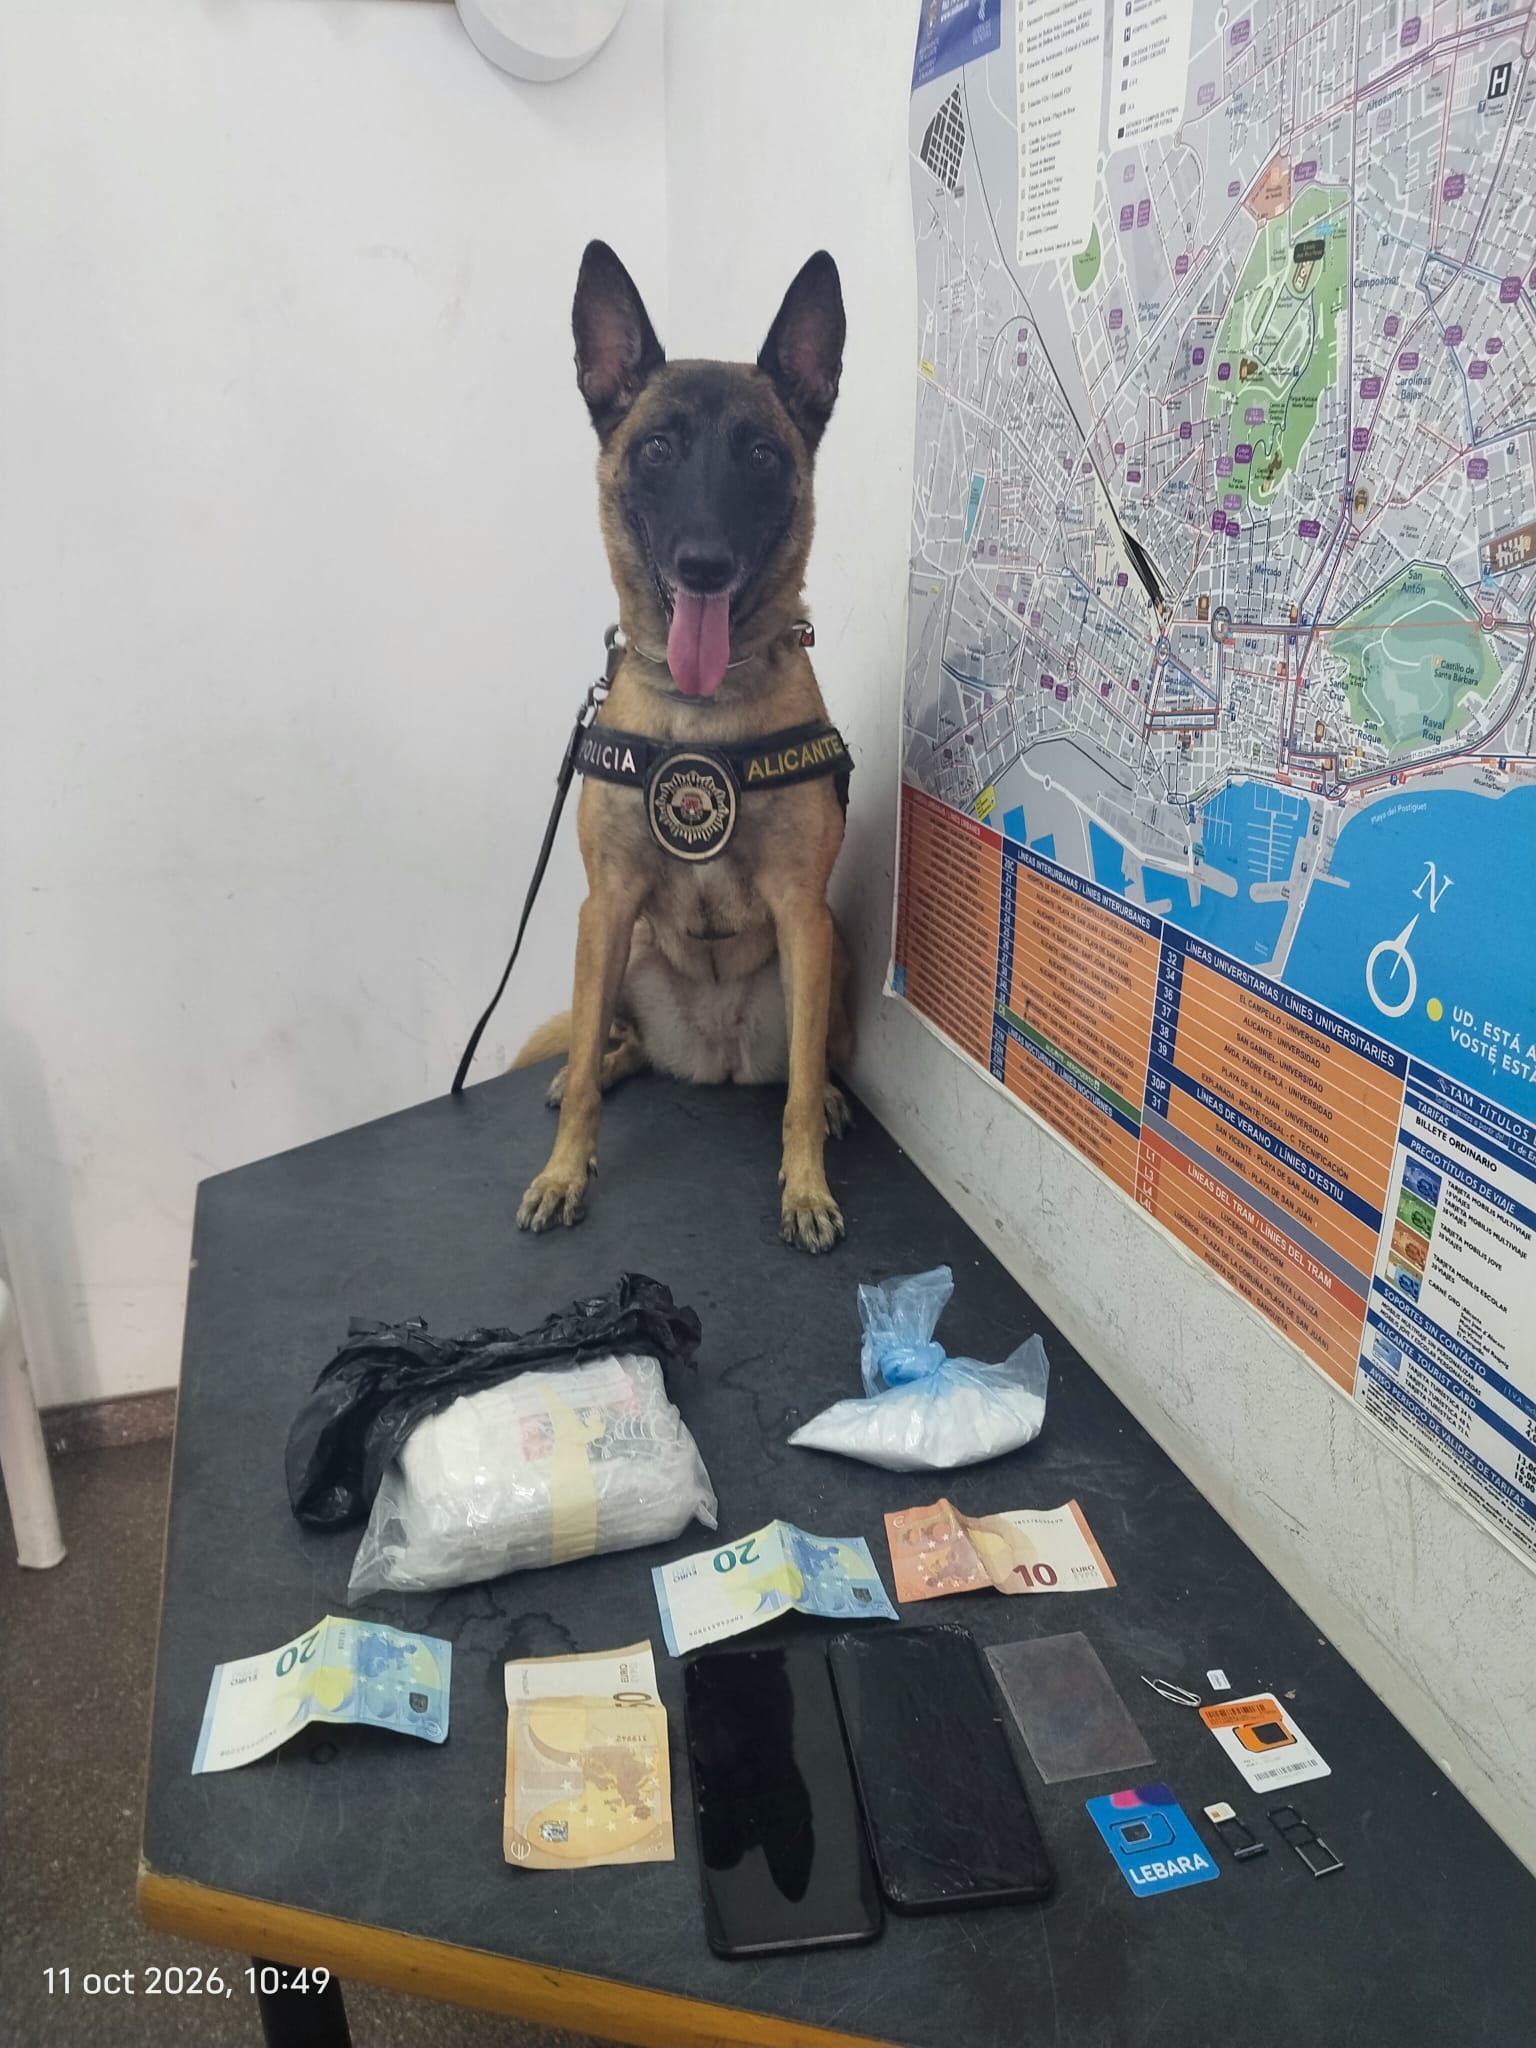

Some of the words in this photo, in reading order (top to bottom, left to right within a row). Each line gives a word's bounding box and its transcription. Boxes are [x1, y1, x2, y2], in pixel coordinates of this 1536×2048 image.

[1366, 87, 1402, 113] Altozano
[1395, 376, 1432, 386] Carolinas
[1401, 390, 1423, 401] Bajas
[1254, 564, 1282, 577] Mercado
[1408, 571, 1422, 581] San
[1401, 583, 1425, 595] Antón
[1434, 669, 1452, 680] Santa
[1453, 672, 1479, 686] Bárbara
[1440, 660, 1463, 674] Castillo
[1465, 664, 1475, 674] de
[1329, 677, 1349, 691] Santa
[1329, 690, 1345, 702] Cruz
[1357, 730, 1381, 745] Roque
[1364, 718, 1378, 730] San
[1422, 715, 1446, 730] Raval
[1422, 729, 1442, 745] Roig
[747, 734, 843, 782] ALICANTE
[1036, 860, 1078, 891] INTERURBANAS
[1082, 884, 1101, 902] LÍNIES
[1102, 894, 1151, 929] INTERURBANES
[1412, 861, 1455, 913] N
[1165, 967, 1176, 982] 34
[1167, 951, 1177, 966] 32
[1163, 986, 1174, 1001] 36
[1185, 939, 1213, 964] LÍNEAS
[1213, 955, 1279, 1001] UNIVERSITARIAS
[1284, 994, 1314, 1021] LÍNIES
[1314, 1014, 1395, 1068] UNIVERSITARIES
[1161, 1006, 1172, 1020] 37
[1248, 999, 1282, 1026] CAMPELLO
[1285, 1021, 1331, 1054] UNIVERSIDAD
[1453, 1006, 1477, 1031] UD.
[1483, 1022, 1520, 1053] ESTÁ
[1159, 1023, 1170, 1039] 38
[1243, 1016, 1273, 1040] ALICANTE
[1277, 1036, 1321, 1069] UNIVERSIDAD
[1450, 1026, 1498, 1062] VOSTÉ
[1157, 1041, 1168, 1057] 39
[1236, 1032, 1249, 1045] SAN
[1279, 1059, 1324, 1093] UNIVERSIDAD
[1151, 1075, 1166, 1092] 30P
[1242, 1055, 1262, 1074] PADRE
[1288, 1085, 1333, 1121] UNIVERSIDAD
[1151, 1094, 1162, 1110] 31
[1221, 1065, 1240, 1083] PLAYA
[1249, 1084, 1263, 1098] SAN
[1263, 1092, 1281, 1111] JUAN
[1284, 1106, 1329, 1144] UNIVERSIDAD
[1418, 1101, 1449, 1127] TARIFAS
[1449, 1085, 1474, 1107] TAM
[1479, 1103, 1529, 1140] TÍTULOS
[1201, 1072, 1235, 1102] EXPLANADA
[1238, 1098, 1259, 1117] MONTE
[1261, 1113, 1284, 1136] TOSSAL
[1298, 1140, 1349, 1181] TECNIFICACIÓN
[1145, 1148, 1156, 1163] L1
[1196, 1087, 1224, 1114] LÍNEAS
[1224, 1106, 1238, 1124] DE
[1237, 1115, 1271, 1149] VERANO
[1278, 1145, 1307, 1174] LÍNIES
[1307, 1165, 1345, 1202] D'ESTIU
[1415, 1116, 1447, 1142] BILLETE
[1449, 1137, 1497, 1173] ORDINARIO
[1144, 1166, 1154, 1181] L3
[1215, 1123, 1228, 1138] SAN
[1228, 1132, 1252, 1157] VICENTE
[1257, 1152, 1277, 1174] PLAYA
[1287, 1175, 1301, 1191] SAN
[1300, 1184, 1320, 1206] JUAN
[1410, 1140, 1441, 1165] PRECIO
[1442, 1158, 1478, 1190] TÍTULOS
[1479, 1185, 1492, 1199] DE
[1493, 1192, 1516, 1215] VIAJE
[1142, 1182, 1152, 1197] L4
[1215, 1145, 1247, 1175] MUTXAMEL
[1251, 1172, 1271, 1194] PLAYA
[1280, 1193, 1294, 1210] SAN
[1293, 1203, 1313, 1225] JUAN
[1173, 1210, 1200, 1236] LUCEROS
[1187, 1164, 1215, 1192] LÍNEAS
[1215, 1186, 1231, 1207] DEL
[1232, 1196, 1255, 1226] TRAM
[1260, 1220, 1287, 1251] LÍNIES
[1287, 1245, 1305, 1267] DEL
[1306, 1260, 1332, 1289] TRAM
[1448, 1180, 1471, 1200] TARJETA
[1472, 1197, 1496, 1217] MOBILIS
[1497, 1214, 1532, 1240] MULTIVIAJE
[1220, 1211, 1248, 1239] LUCEROS
[1251, 1237, 1284, 1269] BENIDORM
[1444, 1199, 1467, 1218] TARJETA
[1468, 1215, 1492, 1235] MOBILIS
[1493, 1232, 1527, 1259] MULTIVIAJE
[1197, 1210, 1224, 1238] LUCEROS
[1236, 1241, 1269, 1275] CAMPELLO
[1272, 1273, 1293, 1296] VENTA
[1440, 1222, 1463, 1243] TARJETA
[1464, 1240, 1487, 1260] MOBILIS
[1487, 1257, 1502, 1271] JOVE
[1433, 1253, 1456, 1274] TARJETA
[1456, 1272, 1480, 1292] MOBILIS
[1480, 1289, 1508, 1313] ESCOLAR
[1383, 1288, 1423, 1325] SOPORTES
[1424, 1321, 1438, 1337] SIN
[1439, 1334, 1487, 1376] CONTACTO
[1377, 1322, 1415, 1357] ALICANTE
[1417, 1354, 1452, 1387] TOURIST
[1453, 1385, 1476, 1409] CARD
[1369, 1368, 1391, 1389] AVISO
[1429, 1420, 1441, 1434] DE
[1441, 1429, 1476, 1465] VALIDEZ
[1476, 1462, 1490, 1476] DE
[1490, 1472, 1525, 1508] TARIFAS
[712, 1538, 761, 1574] 20
[1070, 1564, 1096, 1574] EURO
[1012, 1563, 1058, 1587] 10
[276, 1630, 320, 1678] 20
[1129, 1853, 1209, 1884] LEBARA
